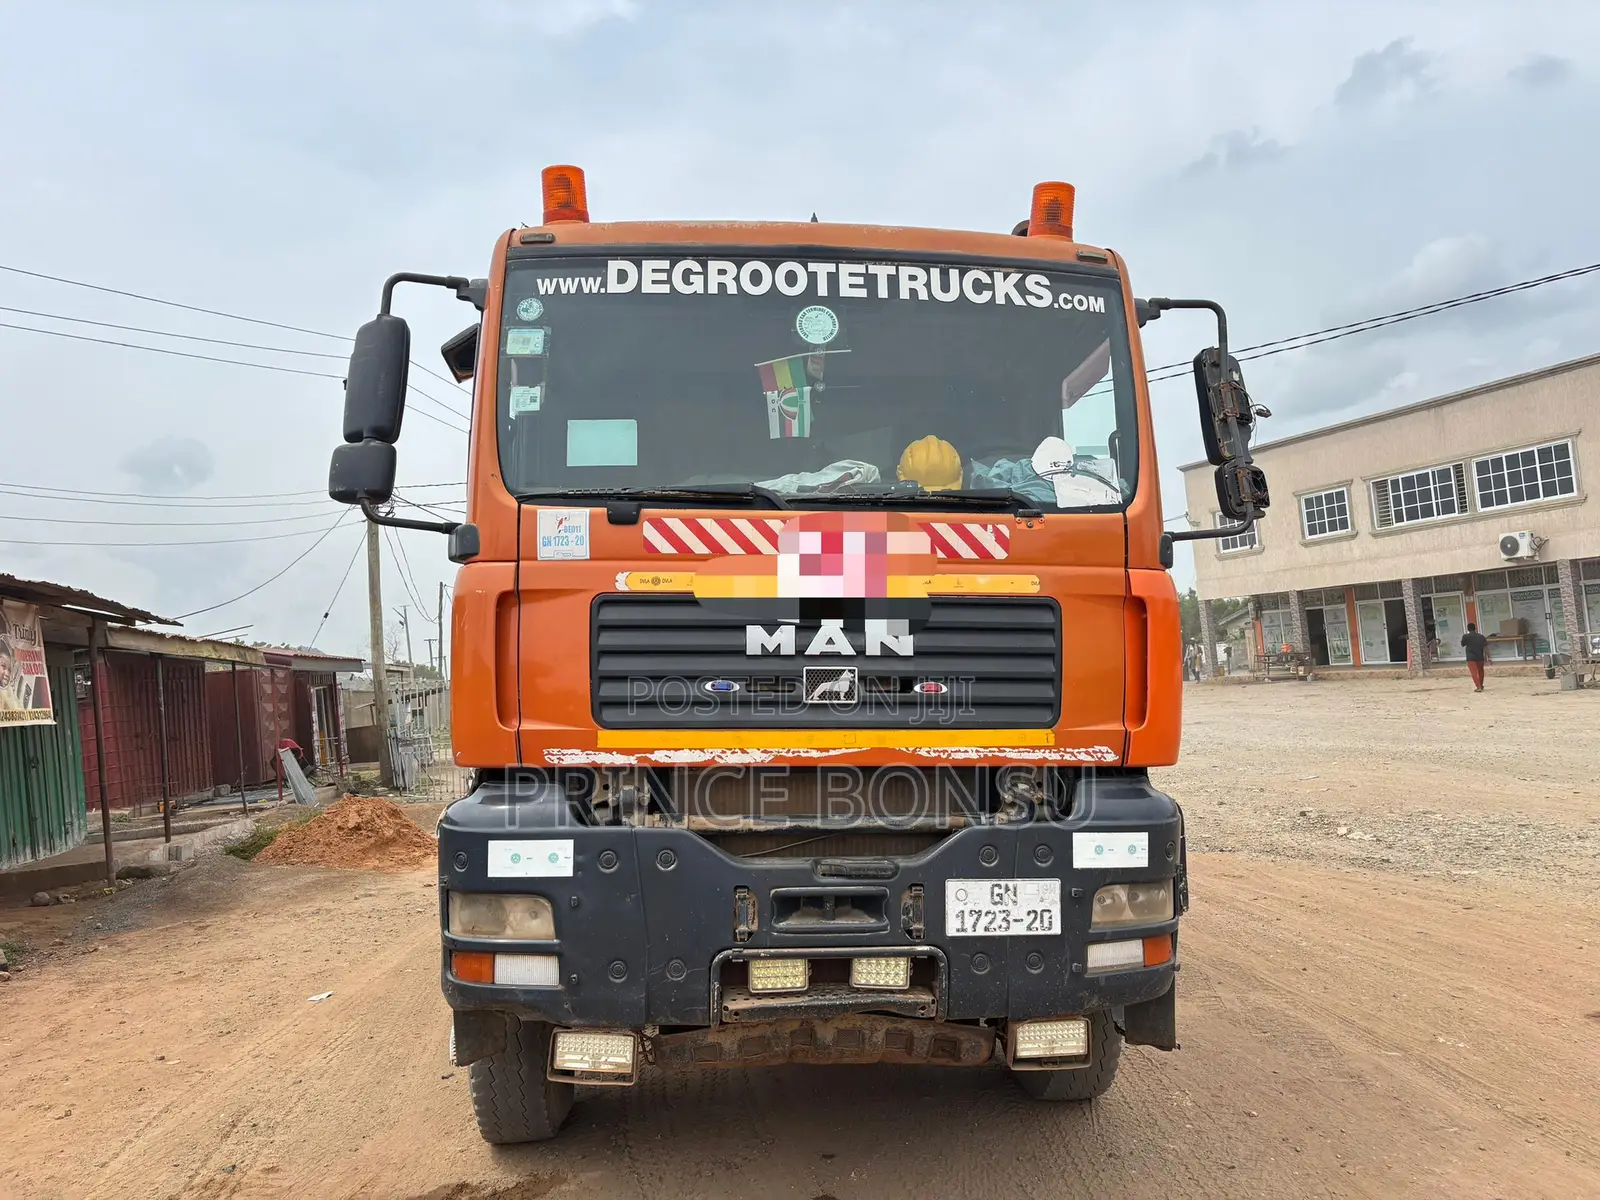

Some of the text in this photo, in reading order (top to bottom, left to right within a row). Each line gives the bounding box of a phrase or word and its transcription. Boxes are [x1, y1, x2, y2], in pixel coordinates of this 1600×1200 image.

[542, 536, 552, 547] GN
[746, 619, 913, 656] MAN
[991, 883, 1018, 906] GN
[955, 909, 1053, 932] 1723-20
